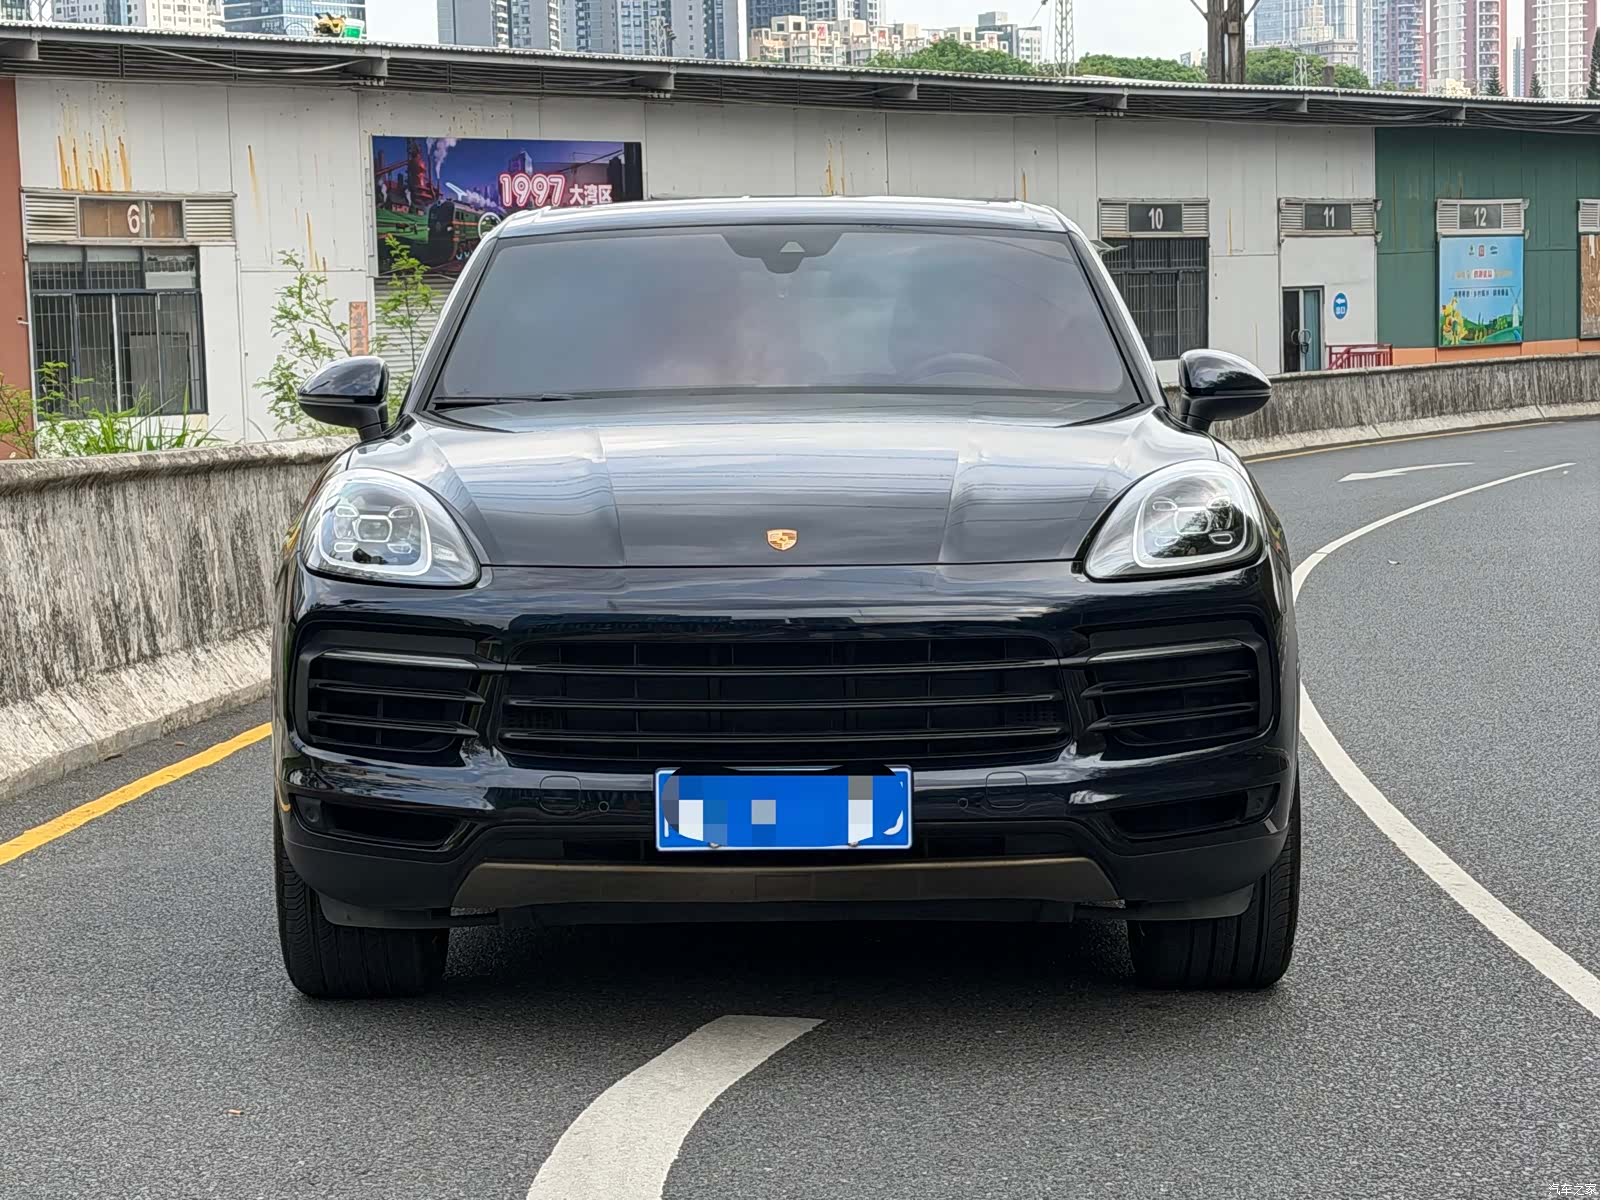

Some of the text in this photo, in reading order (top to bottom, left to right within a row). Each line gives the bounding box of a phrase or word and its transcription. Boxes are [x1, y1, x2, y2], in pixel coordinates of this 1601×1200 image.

[499, 172, 612, 207] 1997 大湾区
[127, 204, 141, 234] 6
[1148, 207, 1163, 230] 10
[1323, 206, 1335, 228] 11
[1474, 207, 1487, 227] 12
